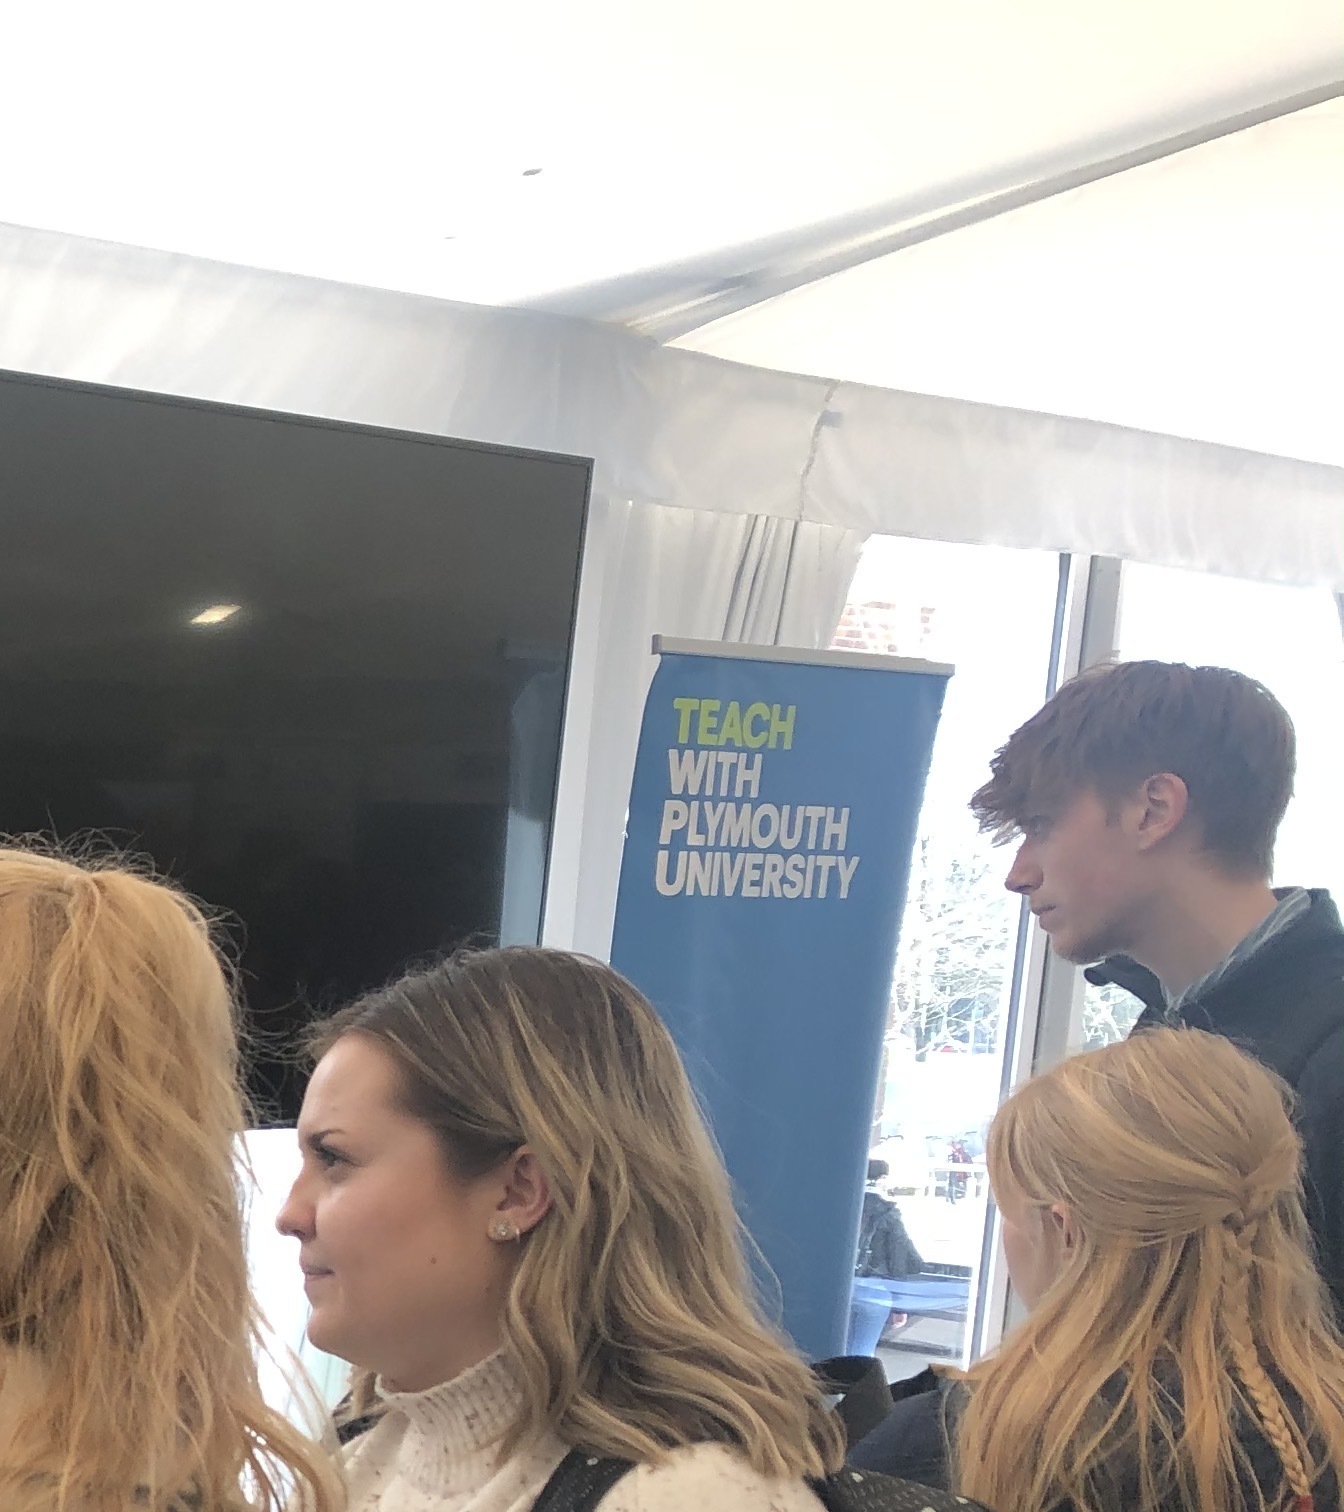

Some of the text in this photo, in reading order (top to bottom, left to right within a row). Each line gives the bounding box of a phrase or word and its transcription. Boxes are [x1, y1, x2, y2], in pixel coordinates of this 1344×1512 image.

[674, 698, 796, 749] TEACH
[669, 749, 762, 798] WITH
[659, 800, 850, 850] PLYMOUTH
[656, 850, 860, 899] UNIVERSITY
